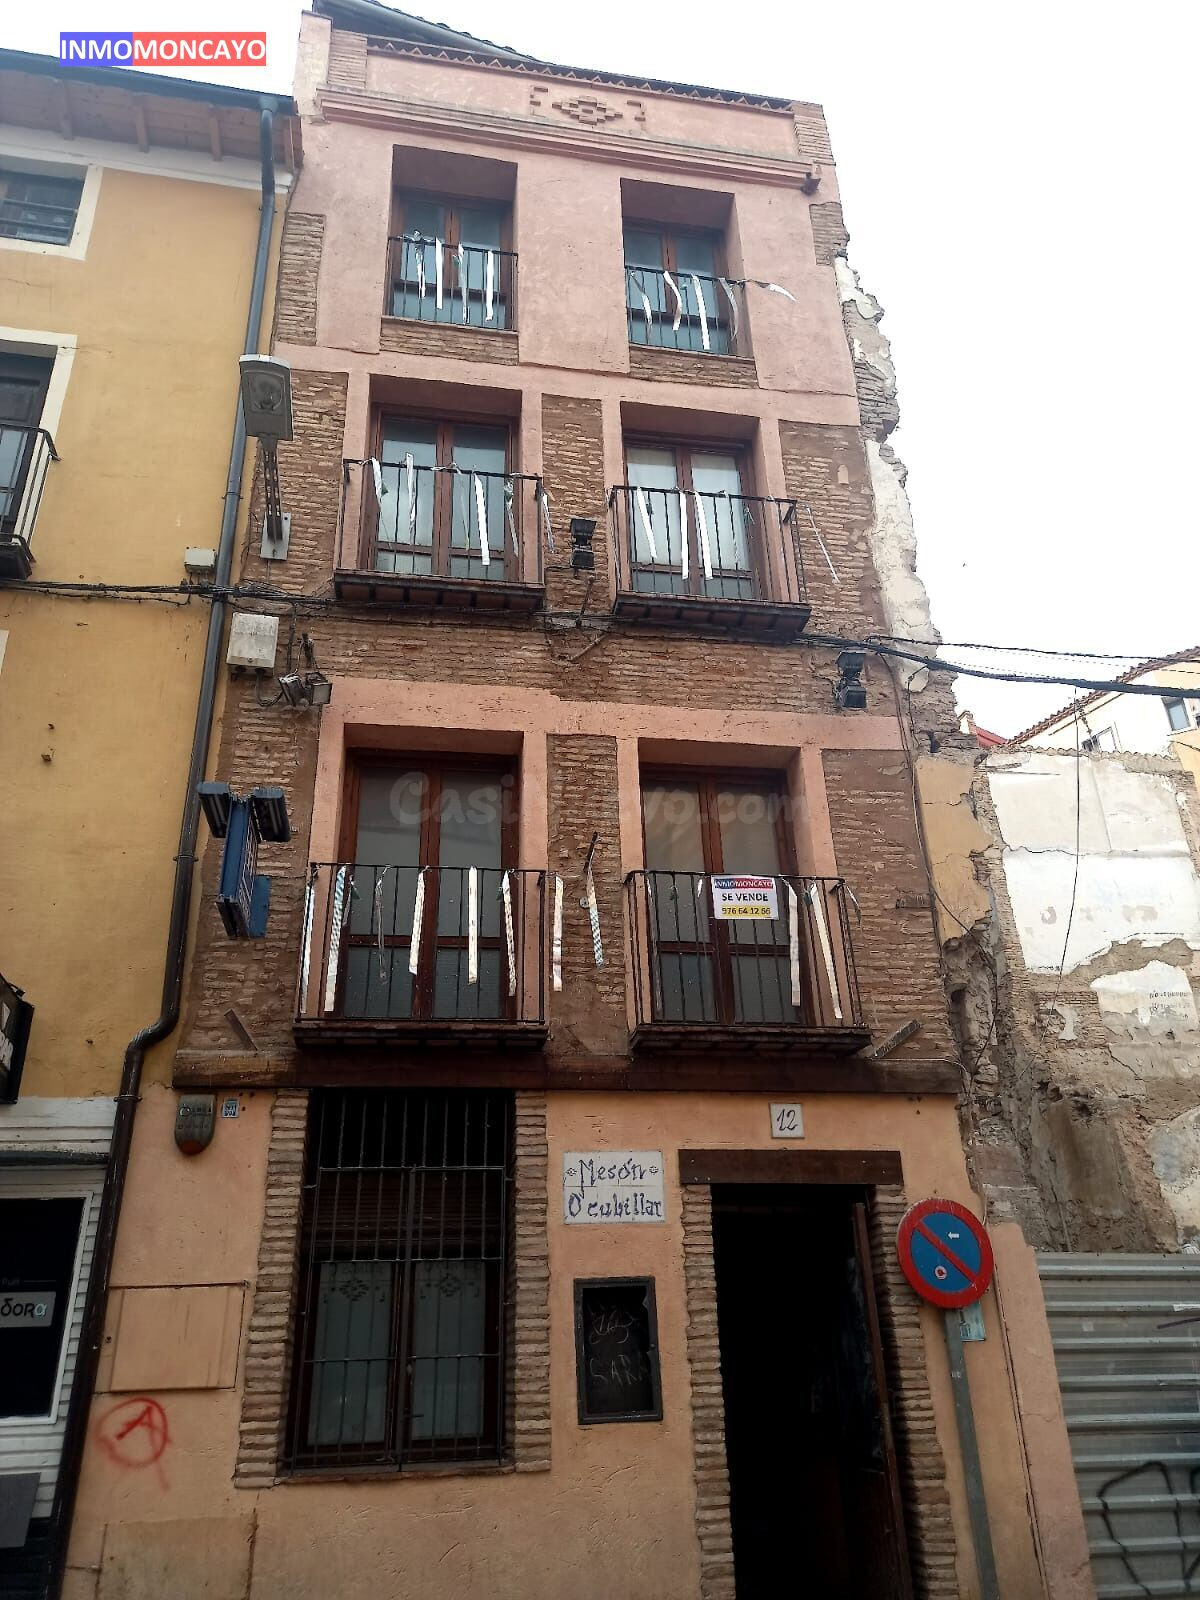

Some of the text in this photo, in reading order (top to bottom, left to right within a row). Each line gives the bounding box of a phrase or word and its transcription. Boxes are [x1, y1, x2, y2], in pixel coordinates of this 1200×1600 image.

[715, 879, 773, 888] INMOMONCAYO
[721, 892, 769, 902] SE VENDE
[721, 907, 737, 915] 976
[738, 907, 748, 915] 64
[750, 907, 759, 915] 12
[776, 1108, 799, 1131] 12
[578, 1157, 647, 1200] Mesón
